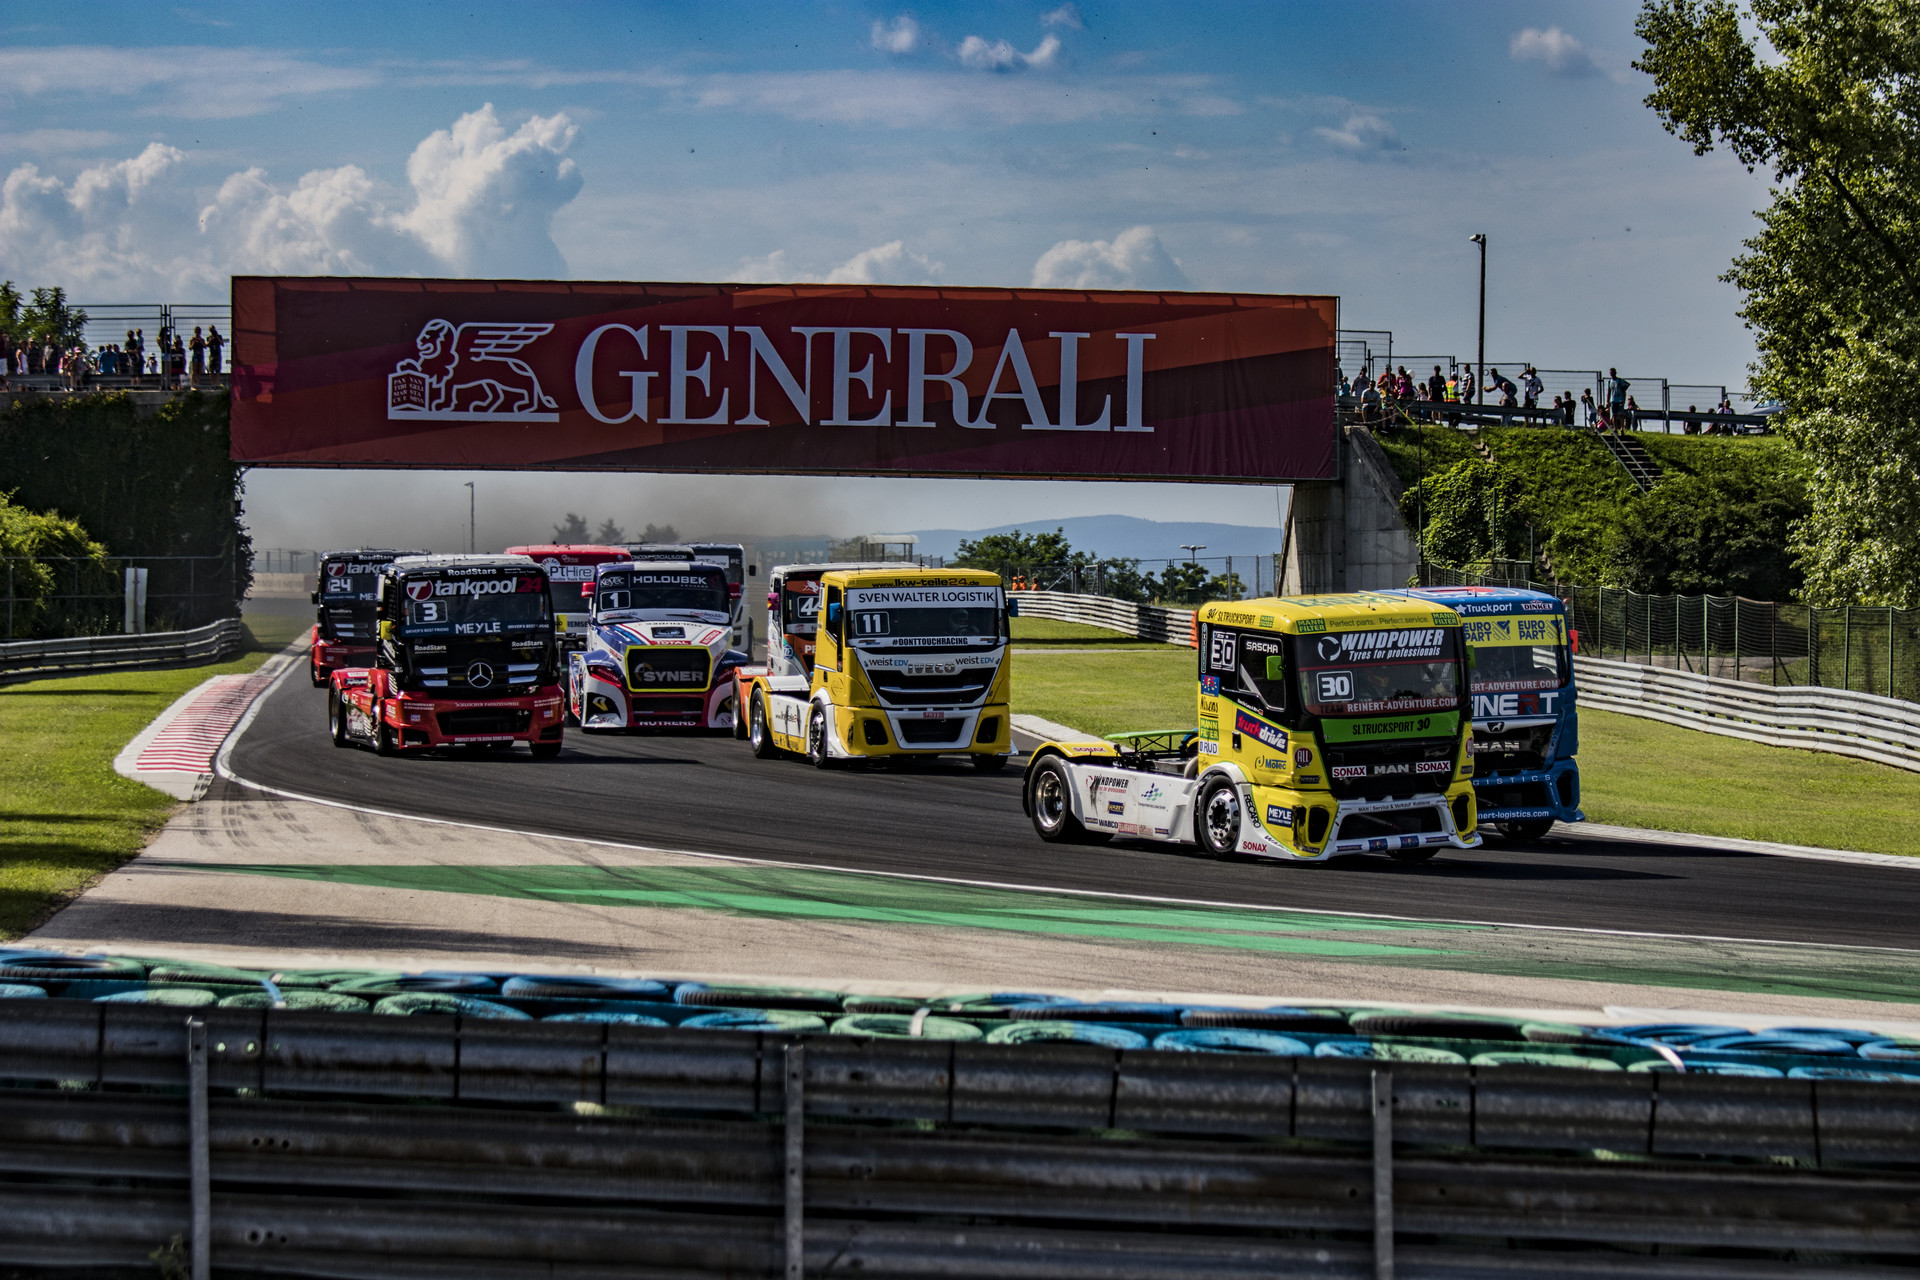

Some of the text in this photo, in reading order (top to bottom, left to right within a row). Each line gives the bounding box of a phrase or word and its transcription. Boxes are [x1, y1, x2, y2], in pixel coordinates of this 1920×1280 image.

[575, 323, 1157, 433] GENERALI
[448, 568, 497, 576] RoadStars
[330, 578, 351, 592] 24
[633, 576, 707, 584] HOLOUBEK
[872, 578, 980, 588] www.lkw-teile24.de
[609, 592, 619, 608] 1
[859, 591, 995, 603] SVEN WALTER LOGISTIK
[422, 603, 438, 620] 3
[1466, 603, 1512, 613] Truckport
[863, 614, 881, 633] 11
[1330, 619, 1376, 628] Perfect parts.
[1404, 616, 1429, 624] service.
[1518, 620, 1545, 631] EURO
[455, 622, 501, 634] MEYLE
[1299, 624, 1325, 632] FILTER
[1463, 622, 1491, 632] EURO
[1341, 629, 1445, 651] WINDPOWER
[1464, 631, 1492, 642] PART
[1519, 630, 1546, 640] PART
[892, 637, 968, 646] #DONTTOUCHRACING
[1246, 641, 1278, 653] SASCHA
[1212, 640, 1233, 666] 30
[1349, 647, 1440, 661] Tyres for professionals
[869, 658, 908, 667] weist EDV
[955, 656, 980, 665] weist
[908, 664, 955, 674] IVECO
[643, 671, 704, 682] SYNER
[1322, 677, 1350, 696] 30
[1320, 698, 1458, 713] TEAM REINERT-ADVENTURE.COM
[1472, 692, 1559, 716] INERT
[1352, 717, 1430, 735] SLTRUCKSPORT 30
[1473, 741, 1519, 752] MAN
[1333, 767, 1365, 777] SONAX
[1374, 764, 1410, 774] MAN
[1417, 762, 1450, 772] SONAX
[1244, 793, 1261, 829] RECARO
[1268, 807, 1292, 821] MEYLE
[1099, 819, 1118, 828] WABCO
[1243, 841, 1267, 853] SONAX
